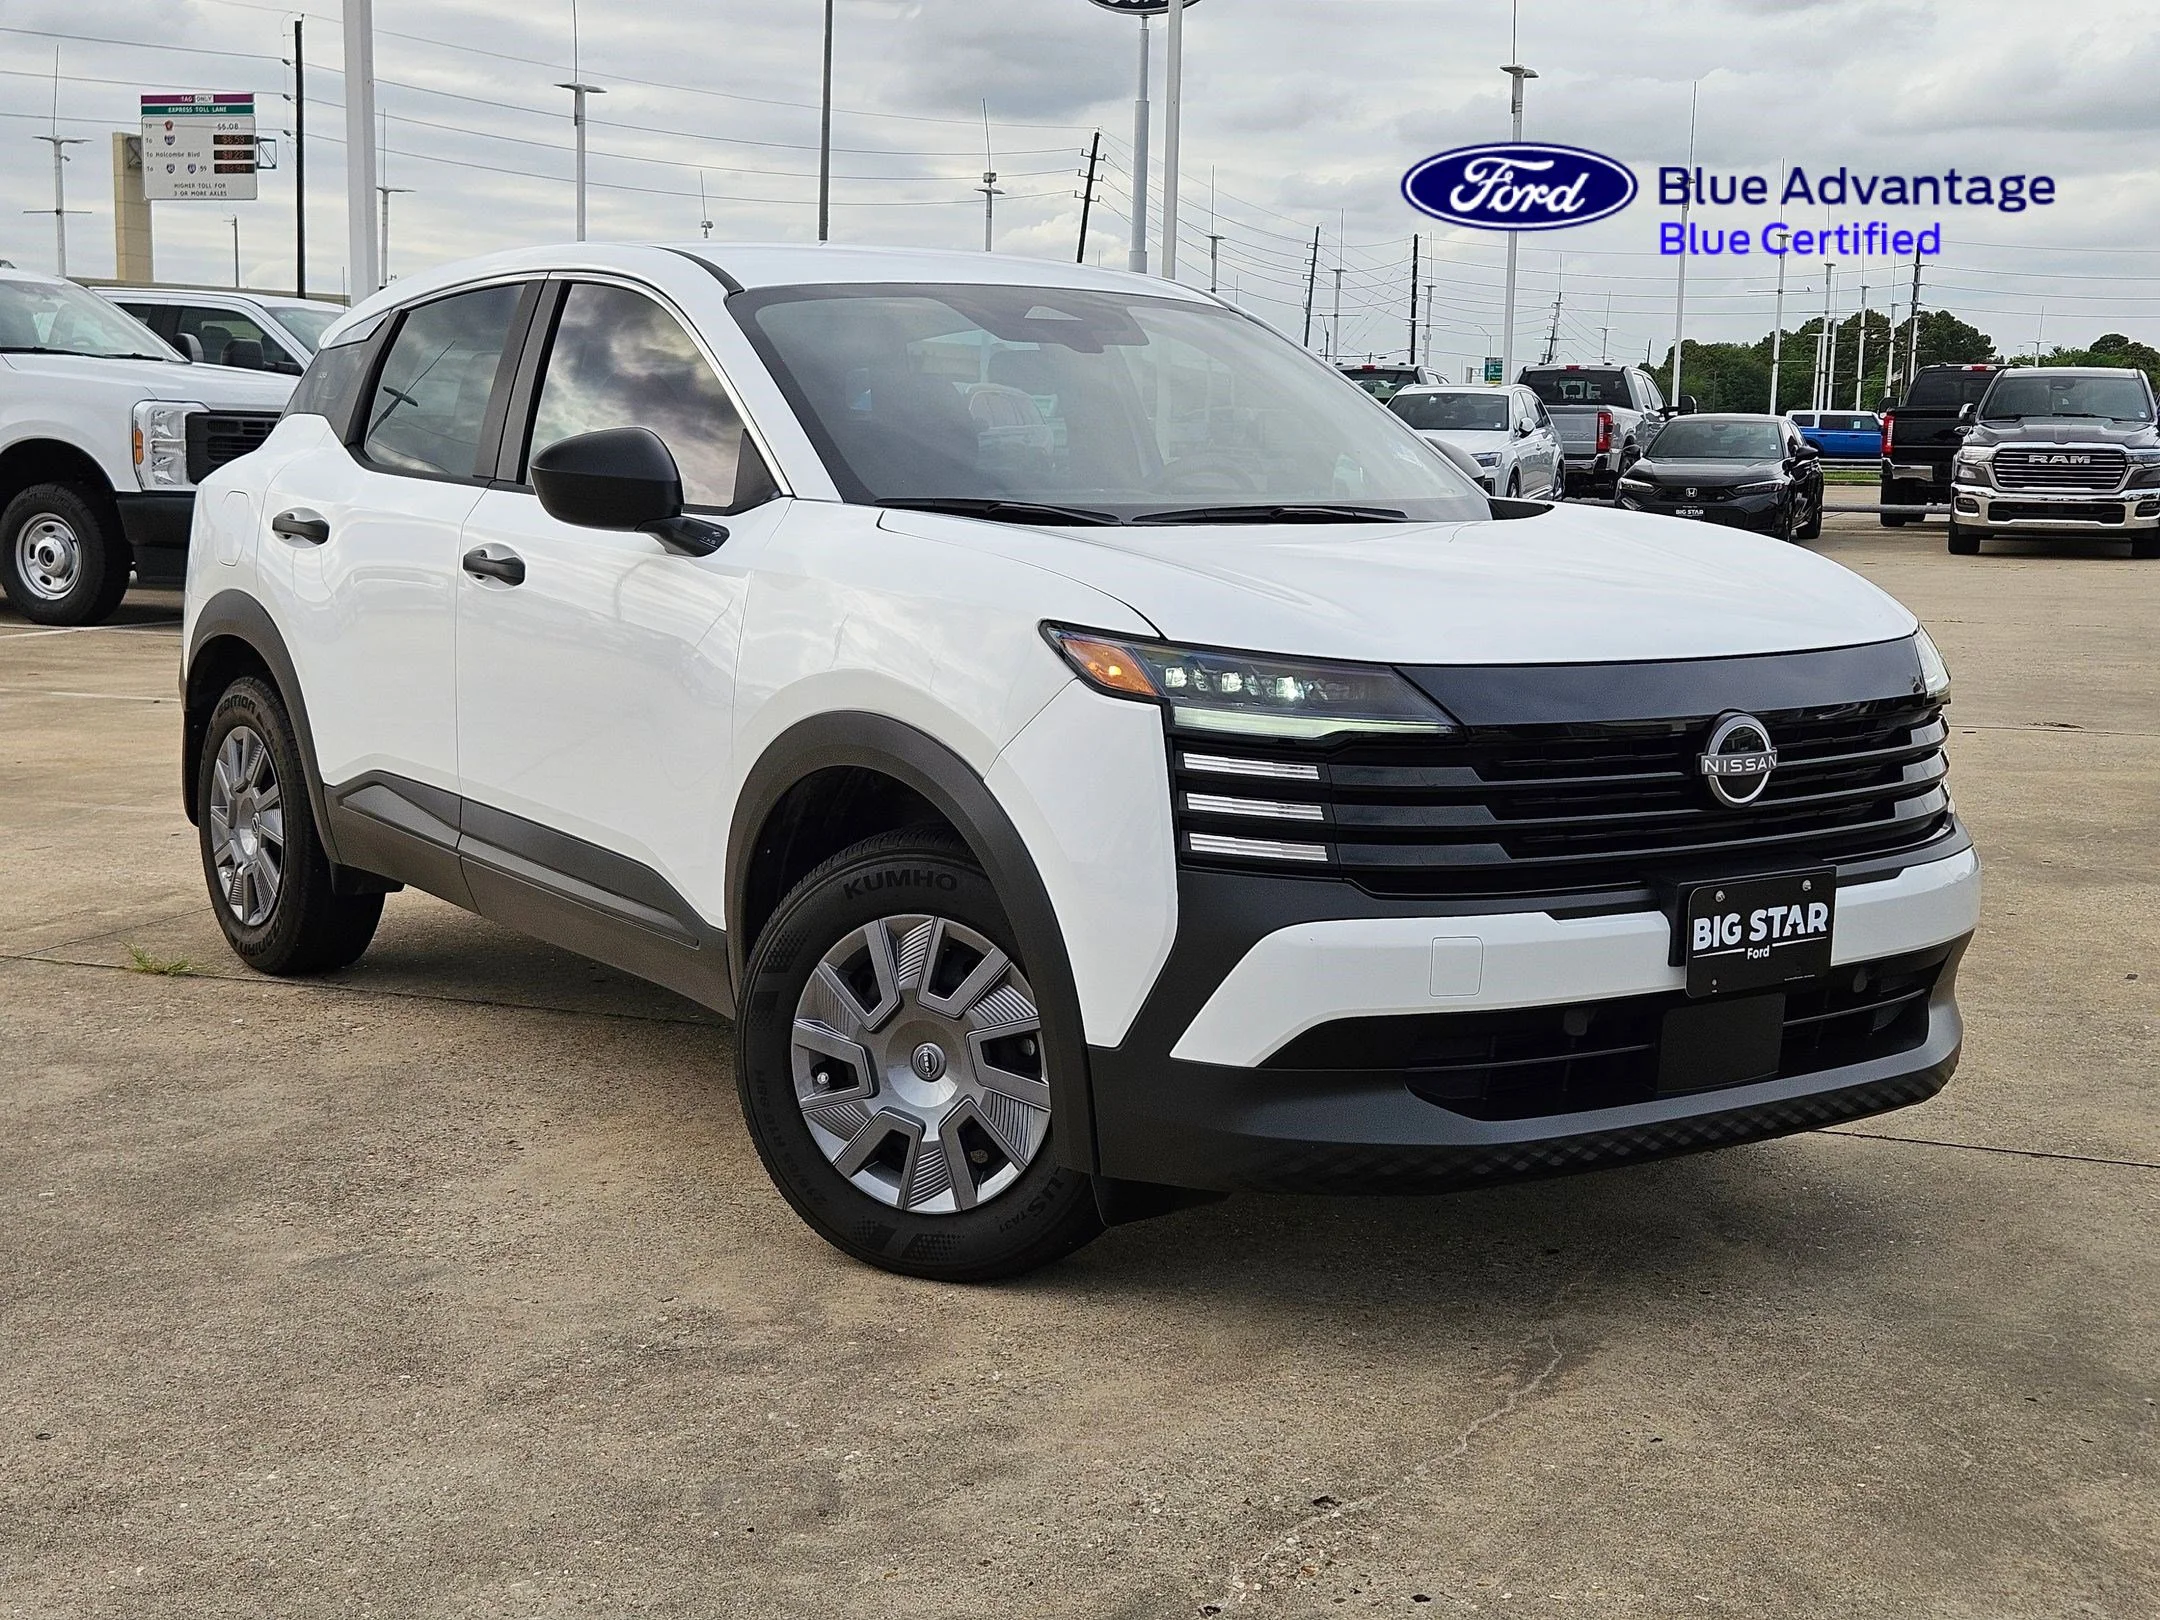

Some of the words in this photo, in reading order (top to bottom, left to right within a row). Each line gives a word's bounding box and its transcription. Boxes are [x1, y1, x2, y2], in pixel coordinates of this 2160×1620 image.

[2028, 454, 2091, 464] RAM
[1704, 753, 1777, 773] NISSAN
[843, 869, 958, 900] KUMHO
[1693, 912, 1742, 951] BIG
[1748, 902, 1829, 941] STAR
[1746, 945, 1770, 960] Ford
